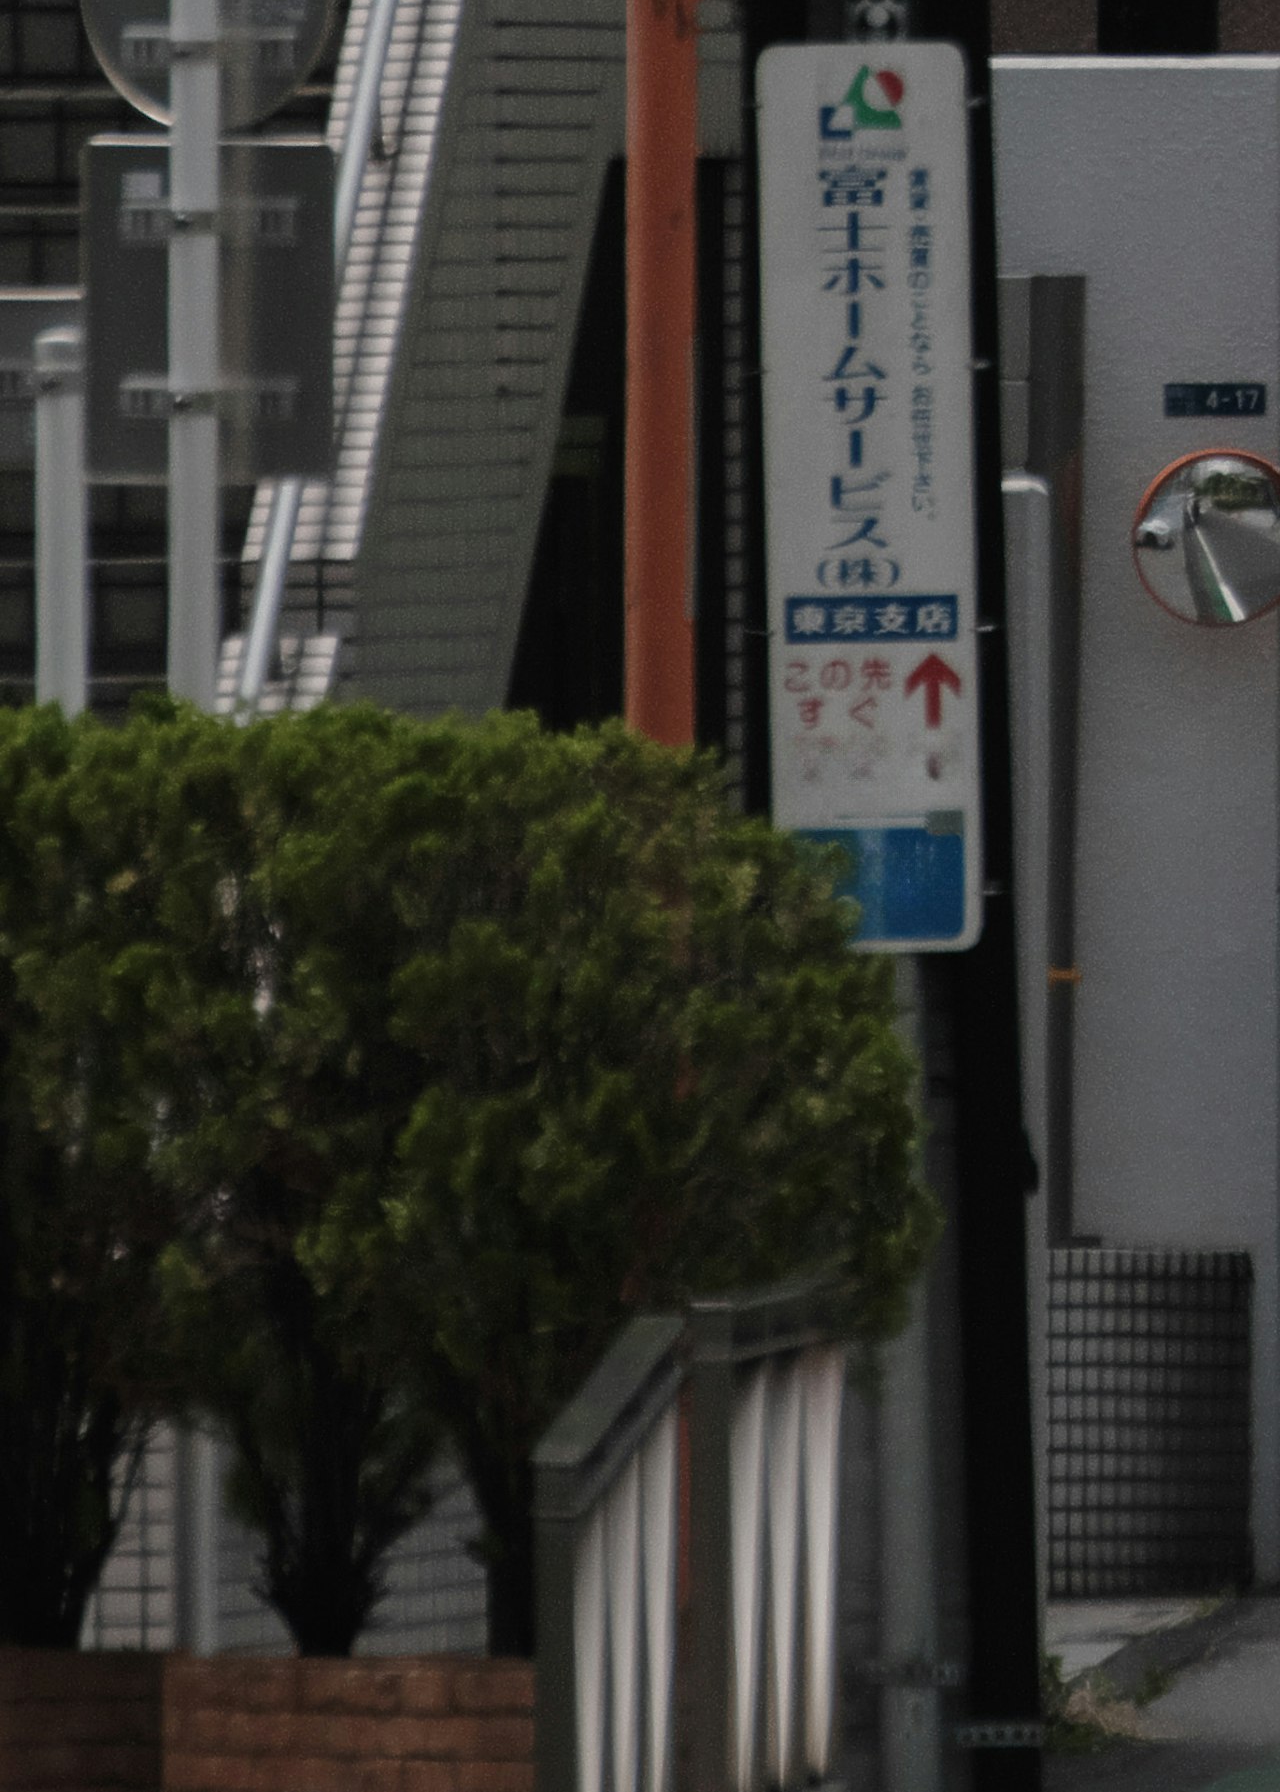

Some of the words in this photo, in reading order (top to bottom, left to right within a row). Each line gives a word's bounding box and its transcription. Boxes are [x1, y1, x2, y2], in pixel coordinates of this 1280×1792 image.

[1206, 390, 1259, 411] 4-17
[792, 602, 954, 638] 東京支店
[785, 657, 893, 693] この先
[797, 696, 881, 729] すぐ
